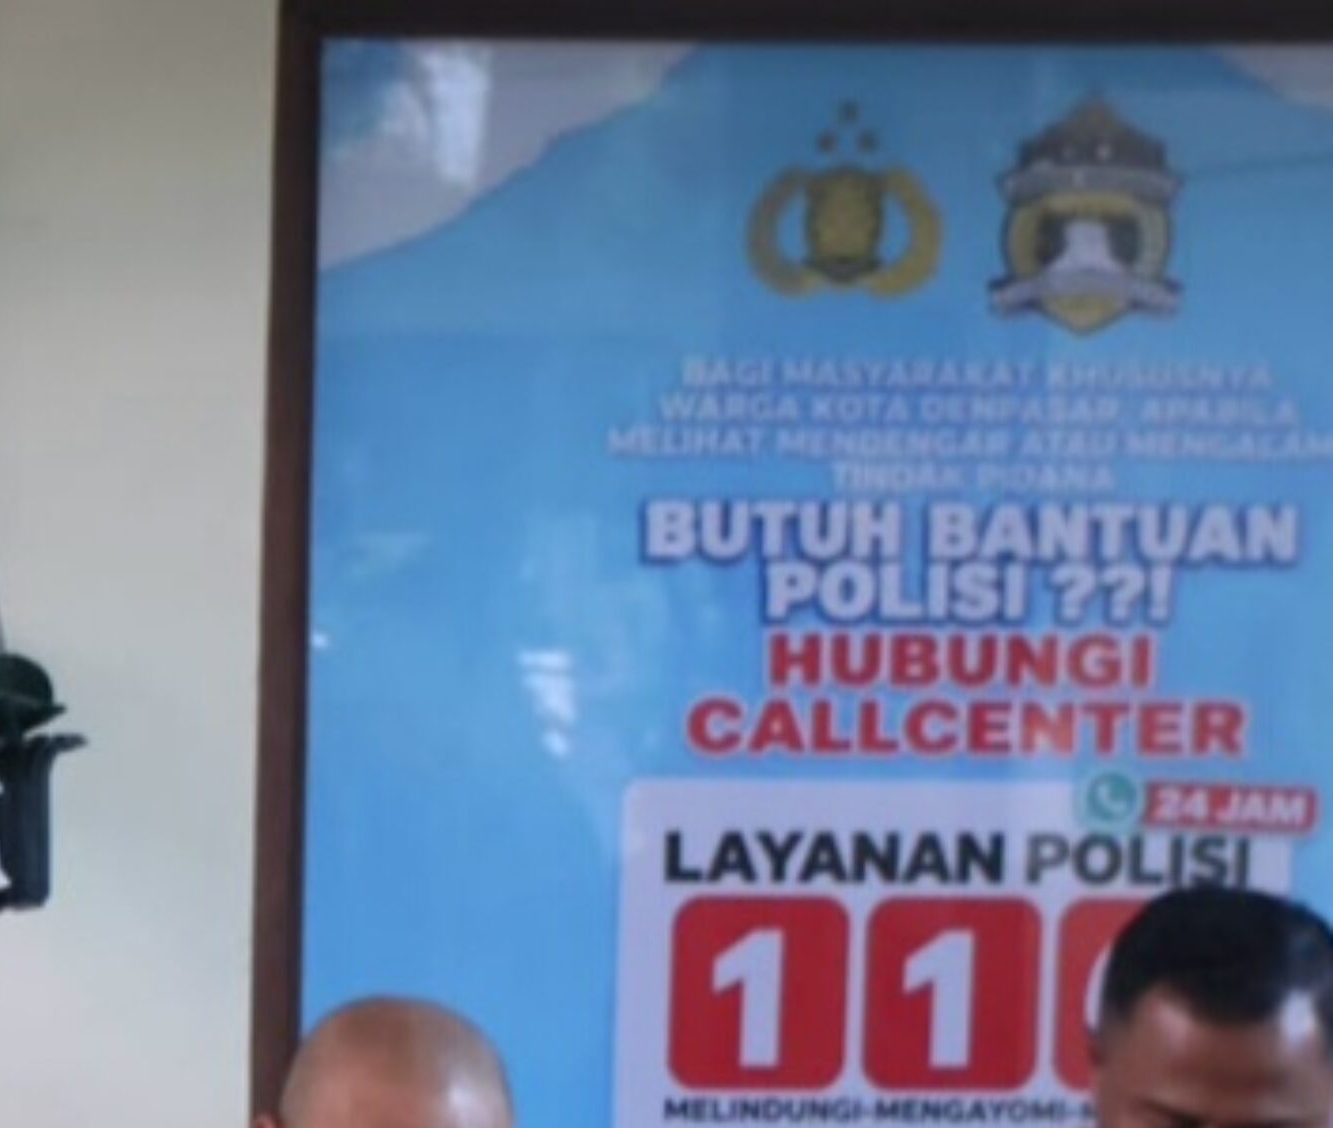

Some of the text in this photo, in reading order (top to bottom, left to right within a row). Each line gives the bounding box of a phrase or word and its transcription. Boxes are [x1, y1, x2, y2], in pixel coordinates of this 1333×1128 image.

[645, 500, 1299, 562] BUTUH BANTUAN
[762, 562, 1024, 622] POLISI
[767, 633, 1153, 689] HUBUNGI
[685, 697, 1247, 755] CALLCENTER
[1153, 786, 1309, 829] 24 JAM
[663, 831, 1252, 890] LAYANAN POLISI
